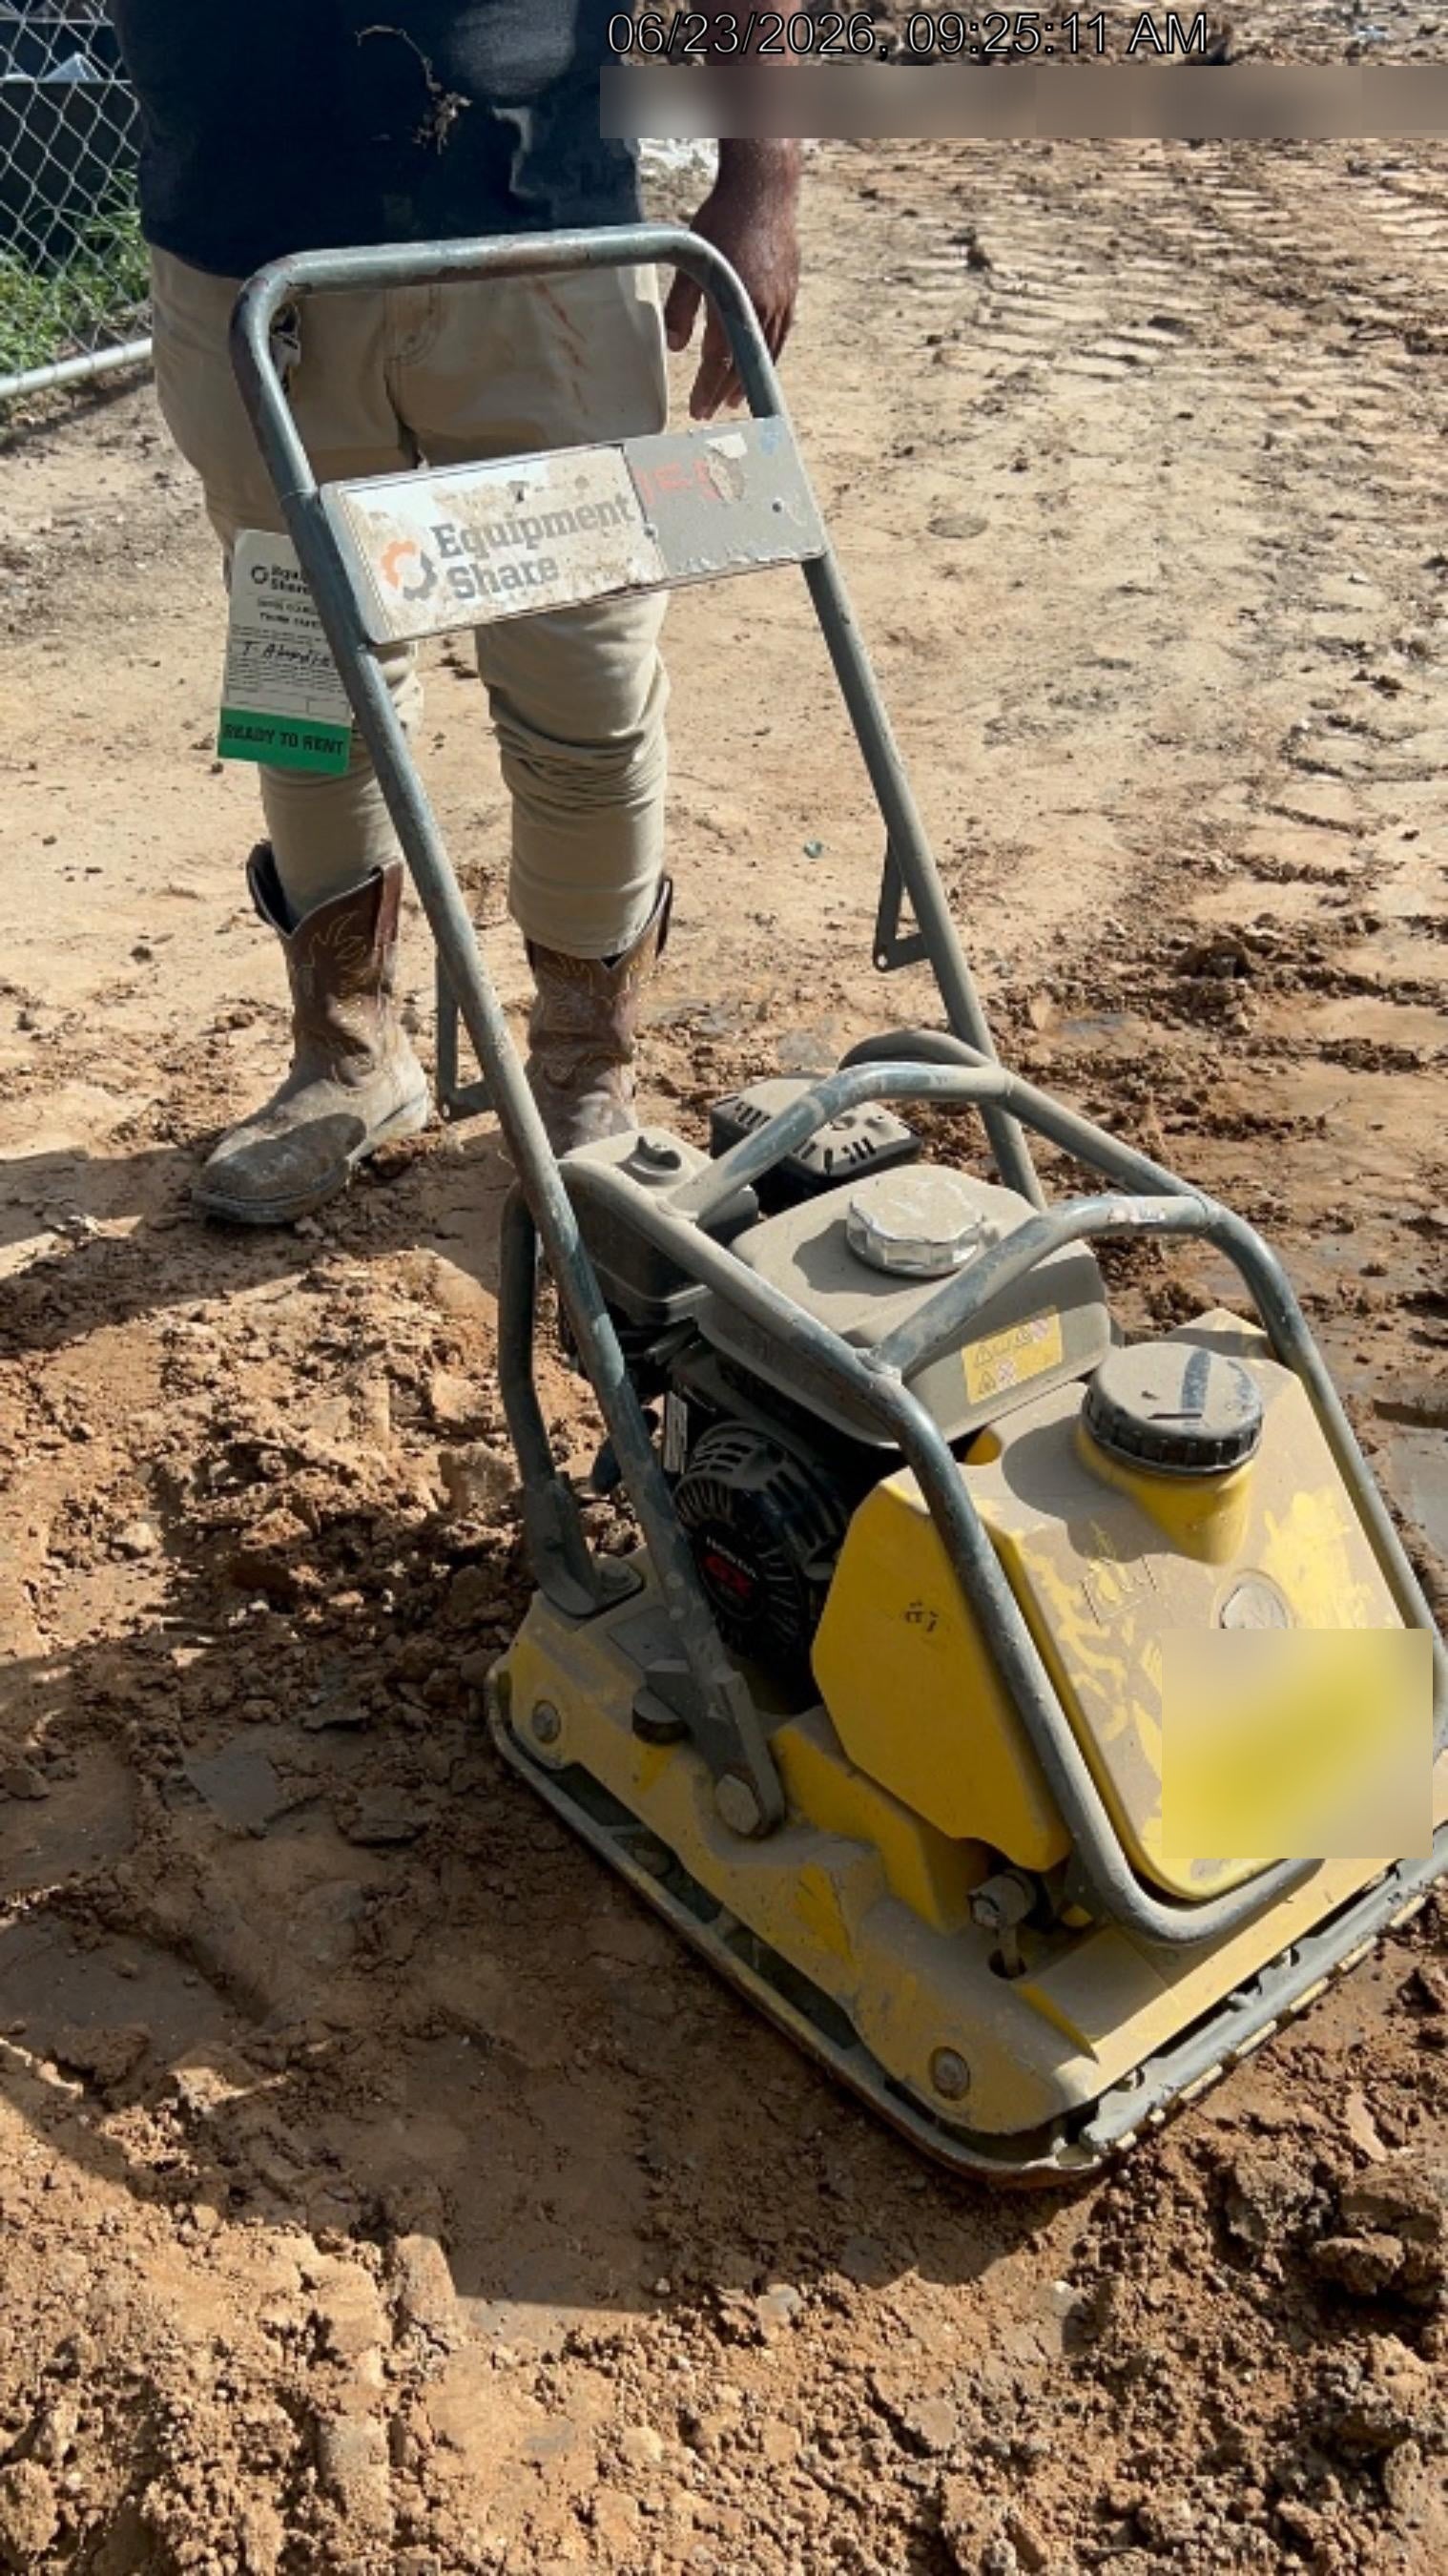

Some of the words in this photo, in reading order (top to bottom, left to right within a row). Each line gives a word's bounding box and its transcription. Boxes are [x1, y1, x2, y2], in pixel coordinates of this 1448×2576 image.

[430, 493, 636, 560] Equipment
[446, 556, 559, 600] Share
[223, 723, 276, 744] READY
[279, 731, 299, 748] TO
[302, 734, 344, 756] RENT
